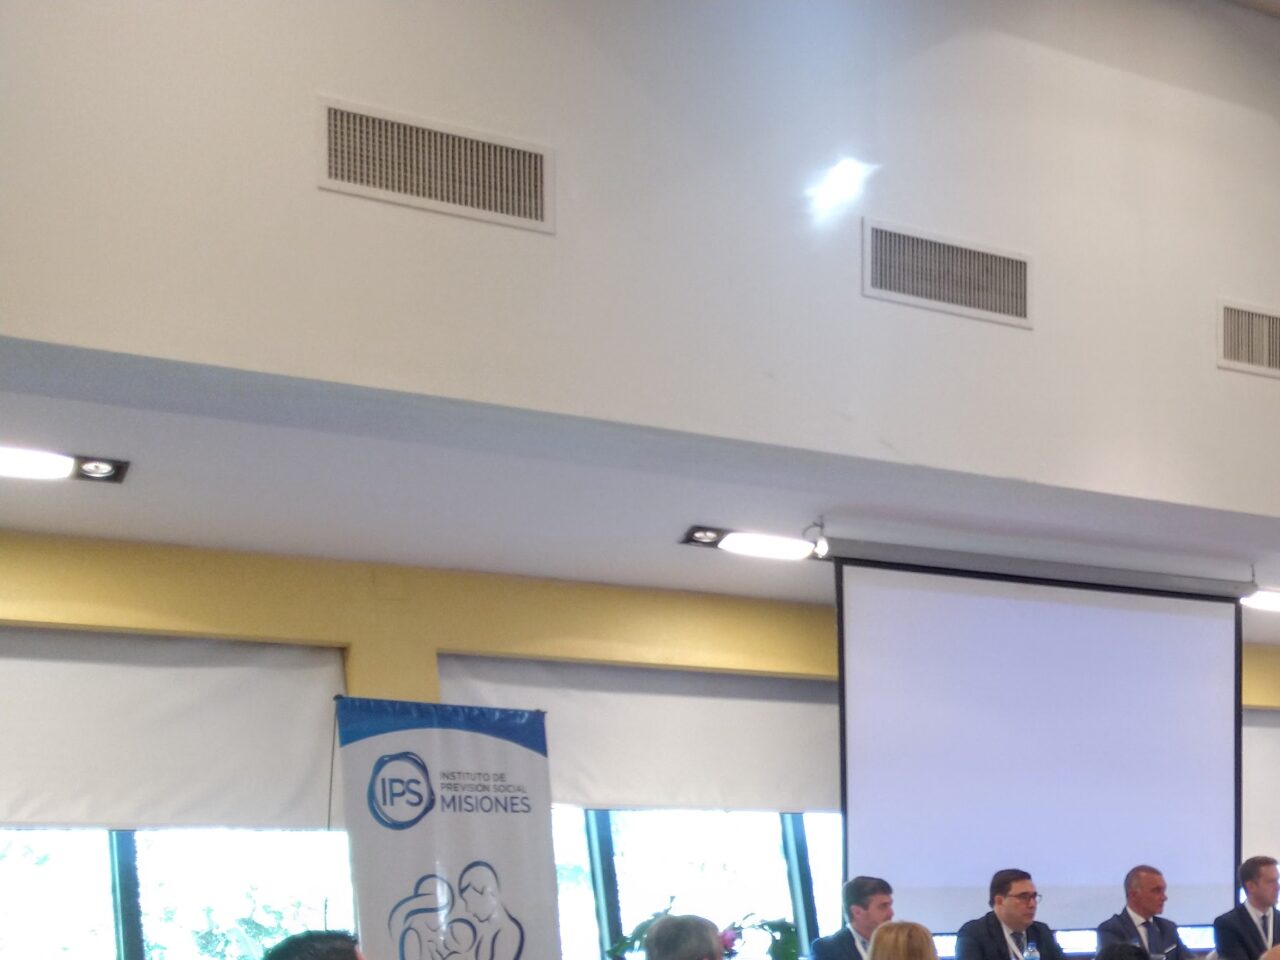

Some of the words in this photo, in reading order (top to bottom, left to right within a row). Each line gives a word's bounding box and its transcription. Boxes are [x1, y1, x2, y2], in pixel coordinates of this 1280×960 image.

[440, 772, 490, 781] INSTITUTO
[493, 773, 507, 782] DE
[380, 778, 424, 807] IPS
[493, 784, 528, 793] SOCIAL
[440, 794, 532, 813] MISIONES
